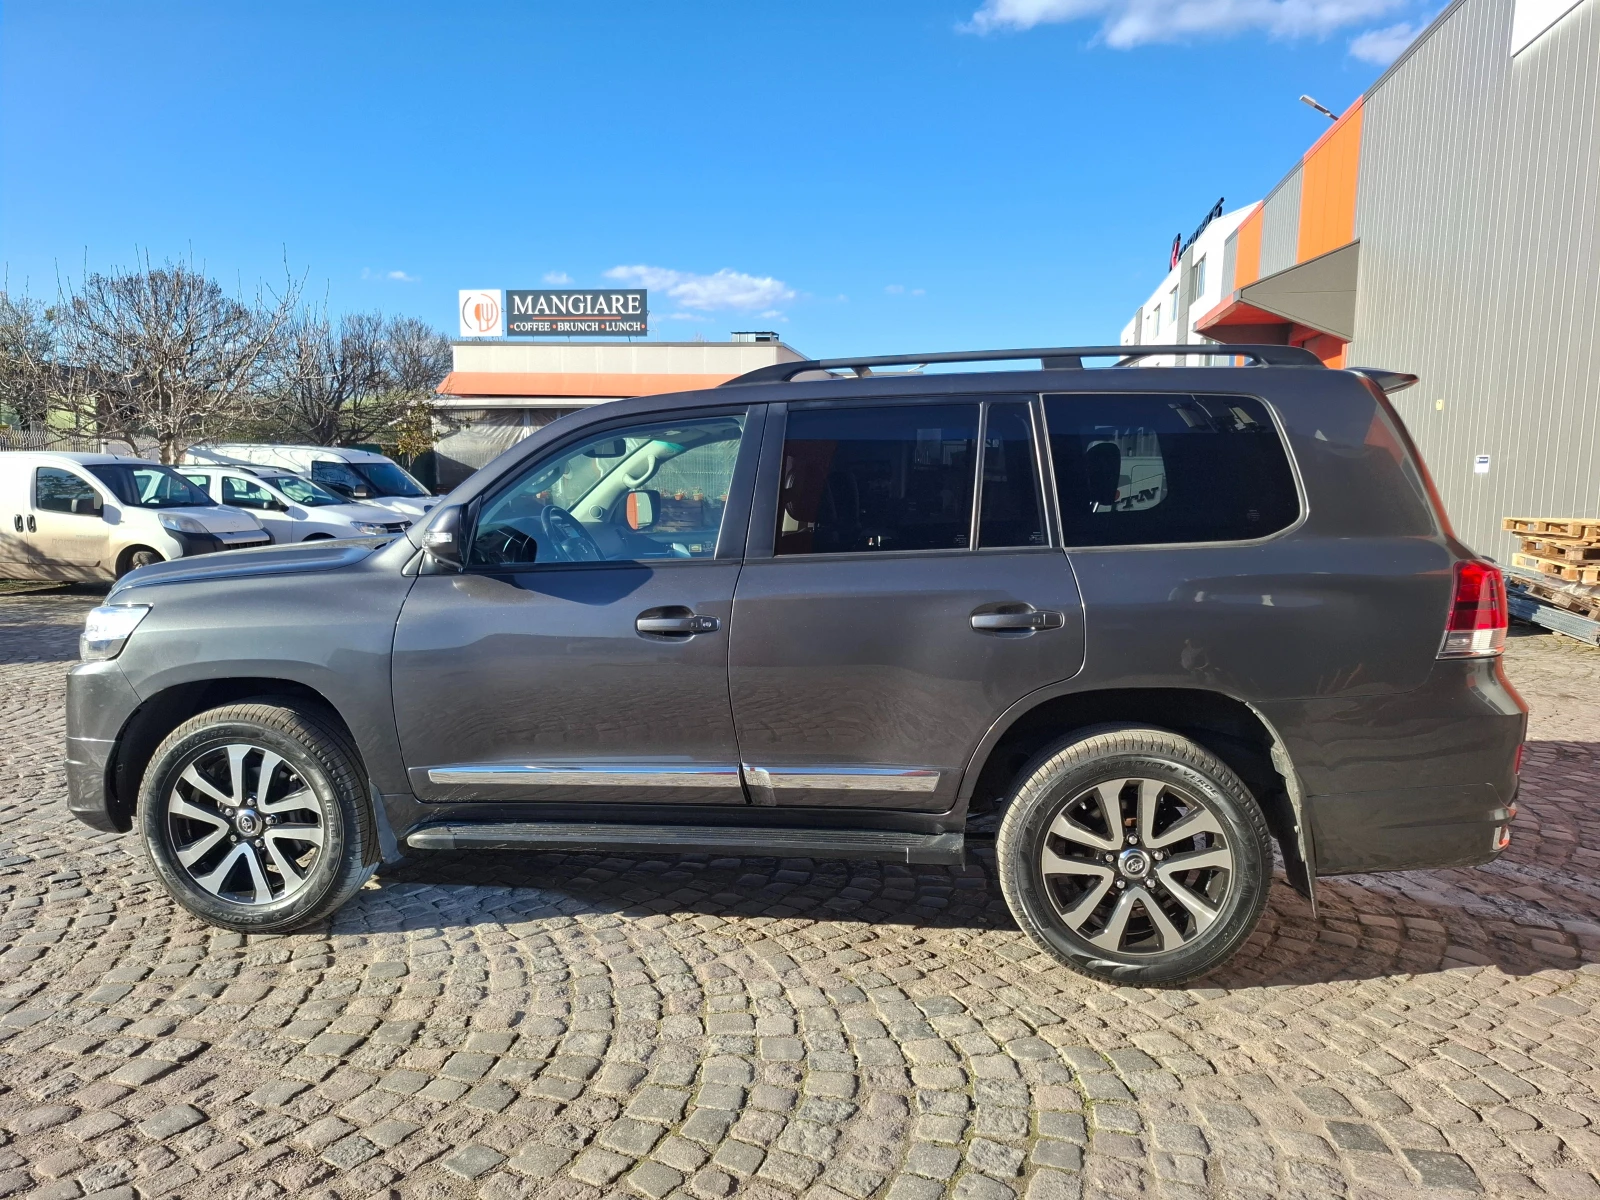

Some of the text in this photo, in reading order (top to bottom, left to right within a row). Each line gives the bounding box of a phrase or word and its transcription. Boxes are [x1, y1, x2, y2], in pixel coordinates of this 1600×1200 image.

[513, 294, 641, 315] MANGIARE
[514, 322, 641, 332] COFFEE BRUNCH LUNCH
